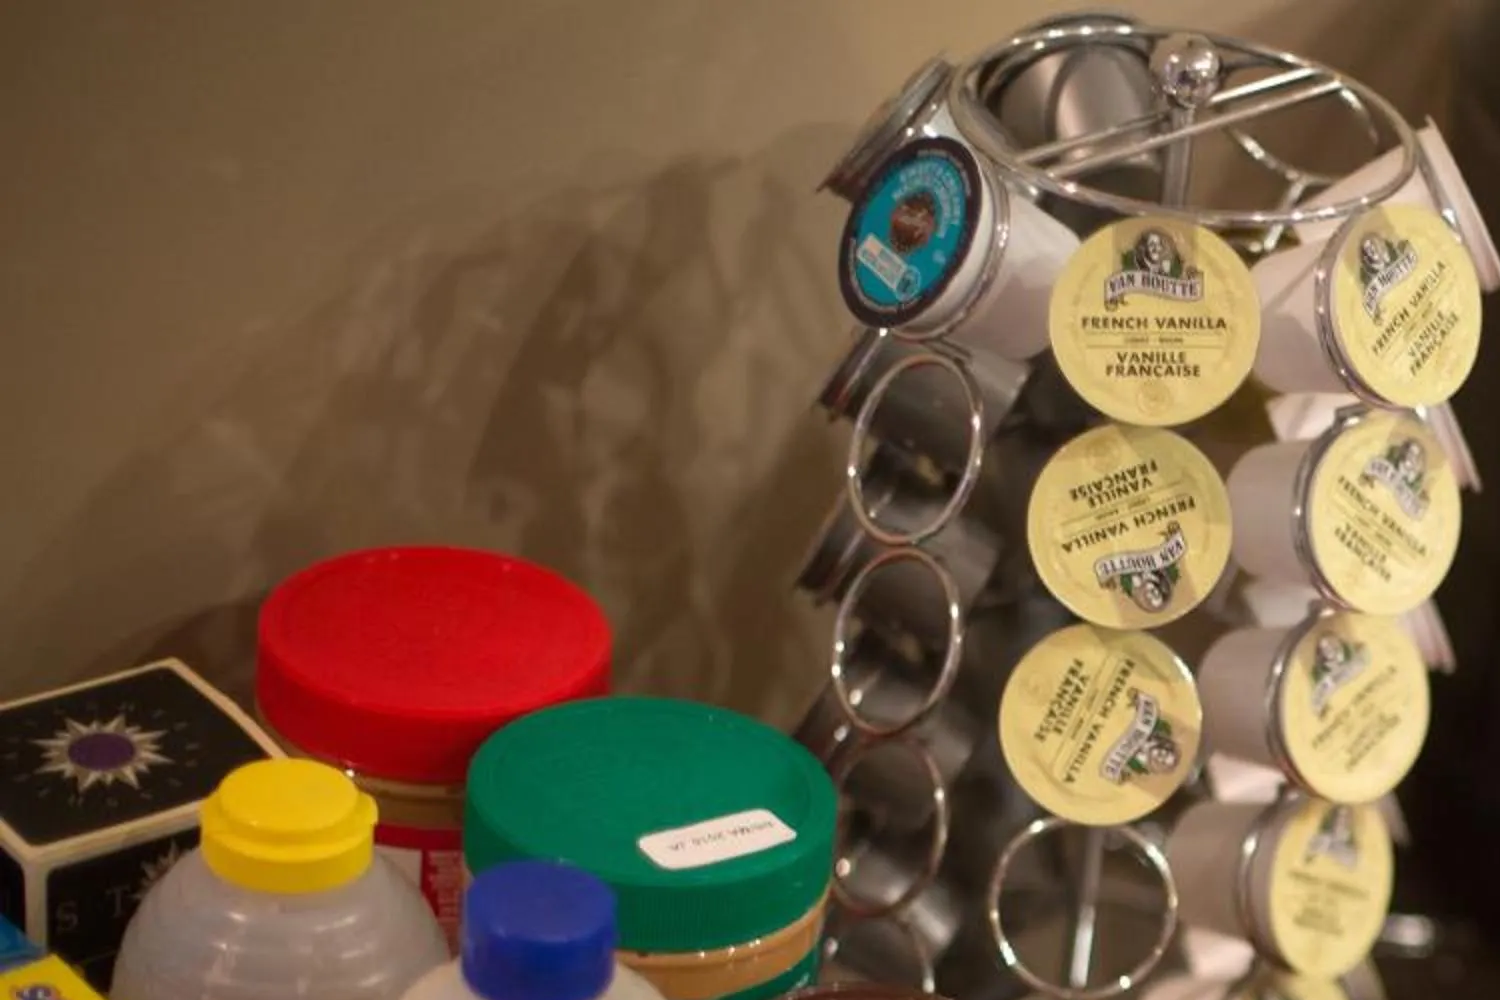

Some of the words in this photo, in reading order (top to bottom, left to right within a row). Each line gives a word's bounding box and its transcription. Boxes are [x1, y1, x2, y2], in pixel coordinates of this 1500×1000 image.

[1109, 274, 1135, 293] VAN
[1141, 273, 1199, 297] HOUTTE
[1081, 316, 1148, 330] FRENCH
[1153, 316, 1227, 330] VANILLA
[1371, 308, 1410, 357] FRENCH
[1409, 260, 1447, 308] VANILLA
[1116, 351, 1187, 365] VANILLE
[1088, 477, 1153, 508] VANILLE
[1133, 496, 1196, 528] FRENCH
[1061, 522, 1130, 553] VANILLA
[1098, 658, 1136, 719] FRENCH
[1052, 674, 1091, 735] VANILLE
[1062, 723, 1104, 784] VANILLA
